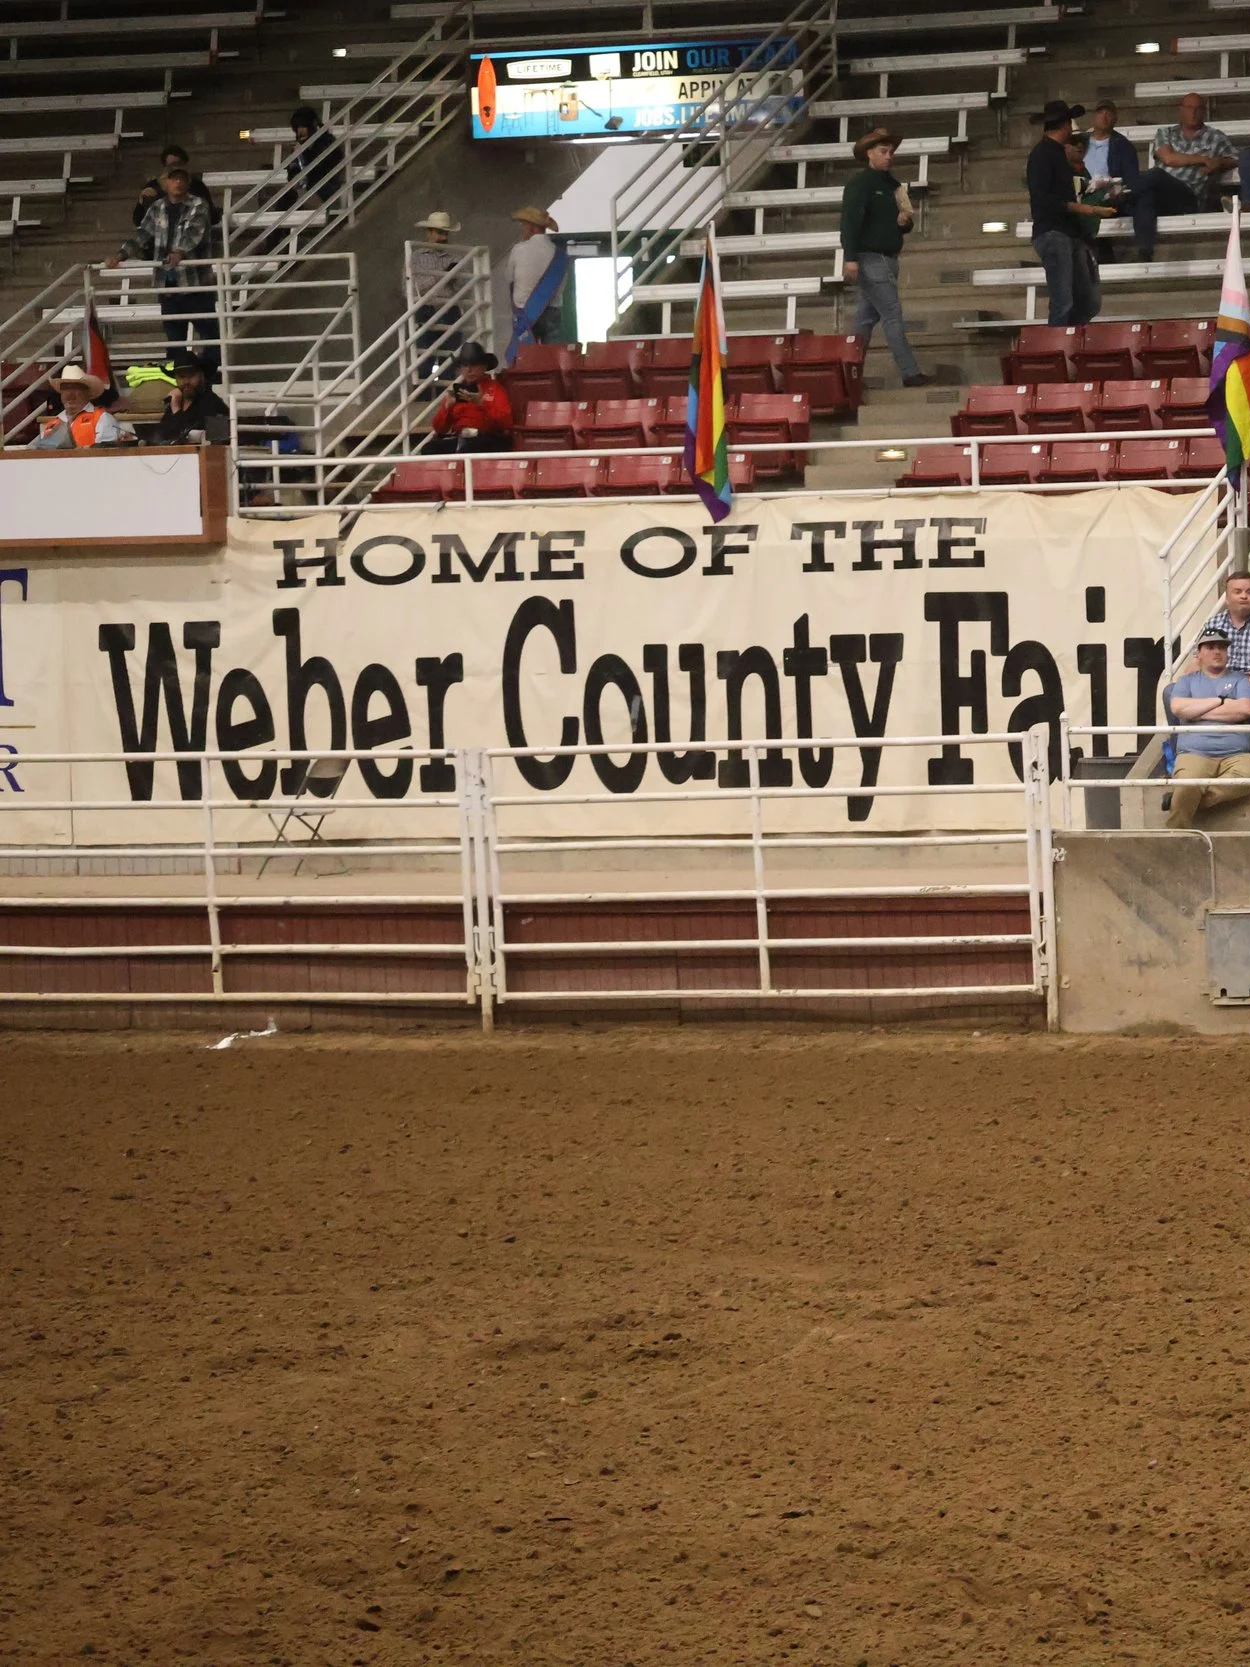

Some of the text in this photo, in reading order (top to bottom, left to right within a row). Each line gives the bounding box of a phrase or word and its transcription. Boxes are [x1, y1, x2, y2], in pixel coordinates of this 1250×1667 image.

[516, 63, 562, 74] LIFETIME
[632, 50, 679, 72] JOIN
[686, 47, 730, 69] OUR
[273, 517, 987, 589] HOME OF THE
[98, 585, 1180, 822] Weber County Fair
